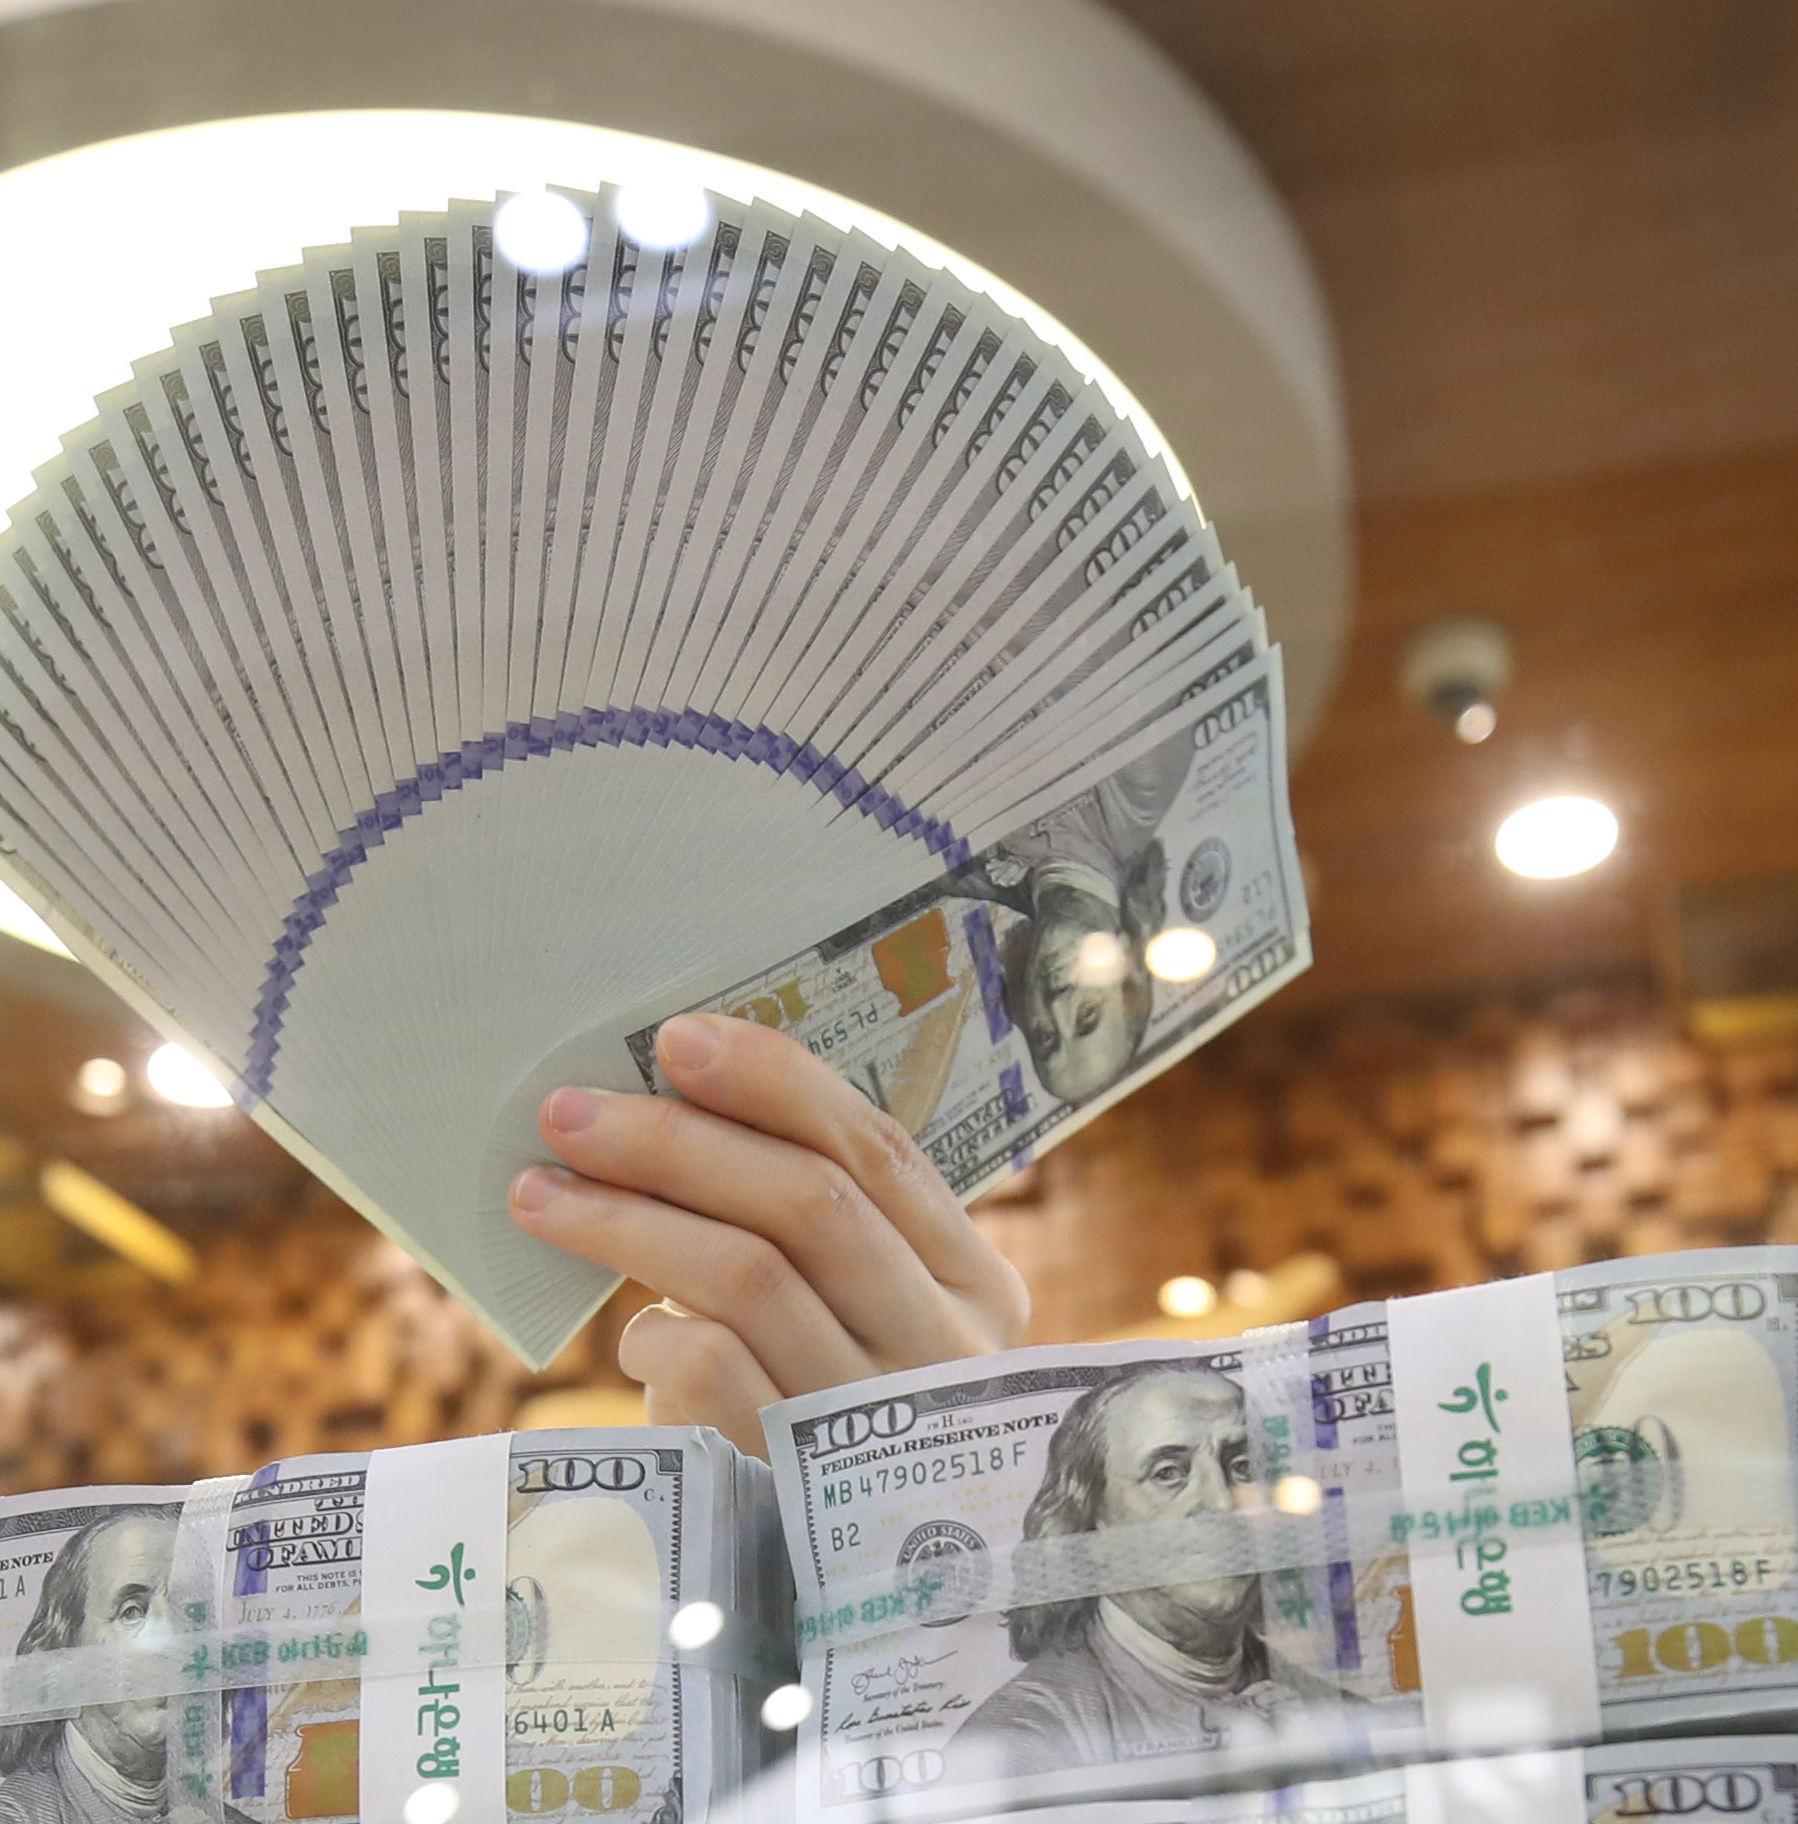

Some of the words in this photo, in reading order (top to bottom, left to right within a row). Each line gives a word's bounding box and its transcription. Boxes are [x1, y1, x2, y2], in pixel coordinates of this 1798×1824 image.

[1190, 690, 1264, 751] 100
[850, 1004, 879, 1029] PL
[1626, 1283, 1765, 1324] 100
[810, 1401, 917, 1458] 100
[821, 1443, 902, 1476] FEDERAL
[903, 1424, 1000, 1453] RESERVE
[1001, 1411, 1059, 1435] NOTE
[517, 1456, 646, 1493] 100
[822, 1479, 853, 1510] MB
[858, 1452, 1004, 1498] 47902518
[831, 1522, 862, 1553] B2
[10, 1552, 54, 1571] NOTE
[297, 1573, 319, 1582] THIS
[321, 1571, 344, 1581] NOTE
[1597, 1561, 1752, 1596] 7902518
[275, 1584, 293, 1593] FOR
[294, 1582, 313, 1591] ALL
[315, 1579, 350, 1591] DEBTS,
[238, 1600, 278, 1625] JULY
[838, 1749, 945, 1795] 100
[1614, 1773, 1763, 1817] 100
